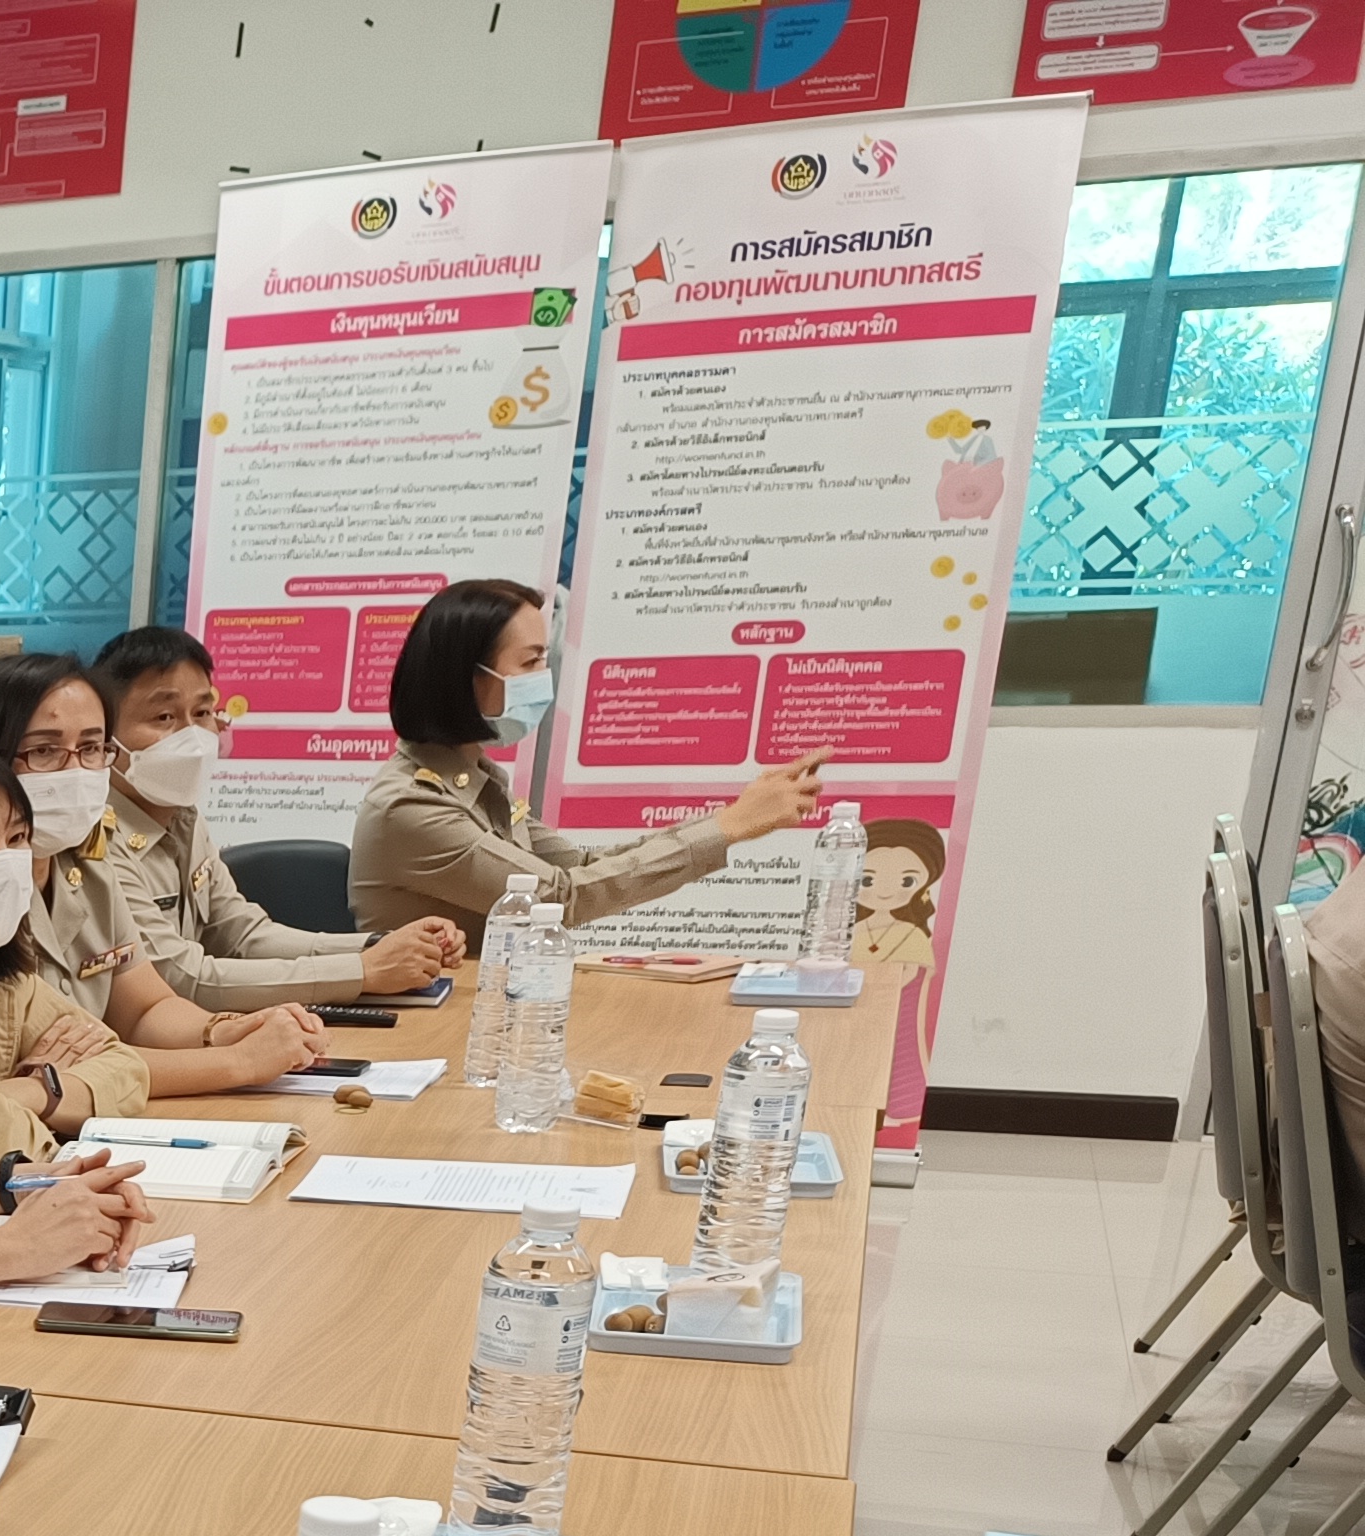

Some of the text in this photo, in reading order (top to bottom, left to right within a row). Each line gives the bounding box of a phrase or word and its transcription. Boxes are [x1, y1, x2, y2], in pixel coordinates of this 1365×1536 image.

[730, 223, 932, 262] การสมัครสมาชิก
[264, 254, 541, 296] ขั้นตอนการขอรับเงินสนับสนุน
[675, 252, 984, 305] กองทุนพัฒนาบทบาทสตรี
[331, 303, 459, 337] เงินทุนหมุนเวียน
[738, 313, 897, 346] การสมัครสมาชิก
[739, 624, 794, 643] หลักฐาน
[307, 734, 389, 760] เงินอุดหนุน
